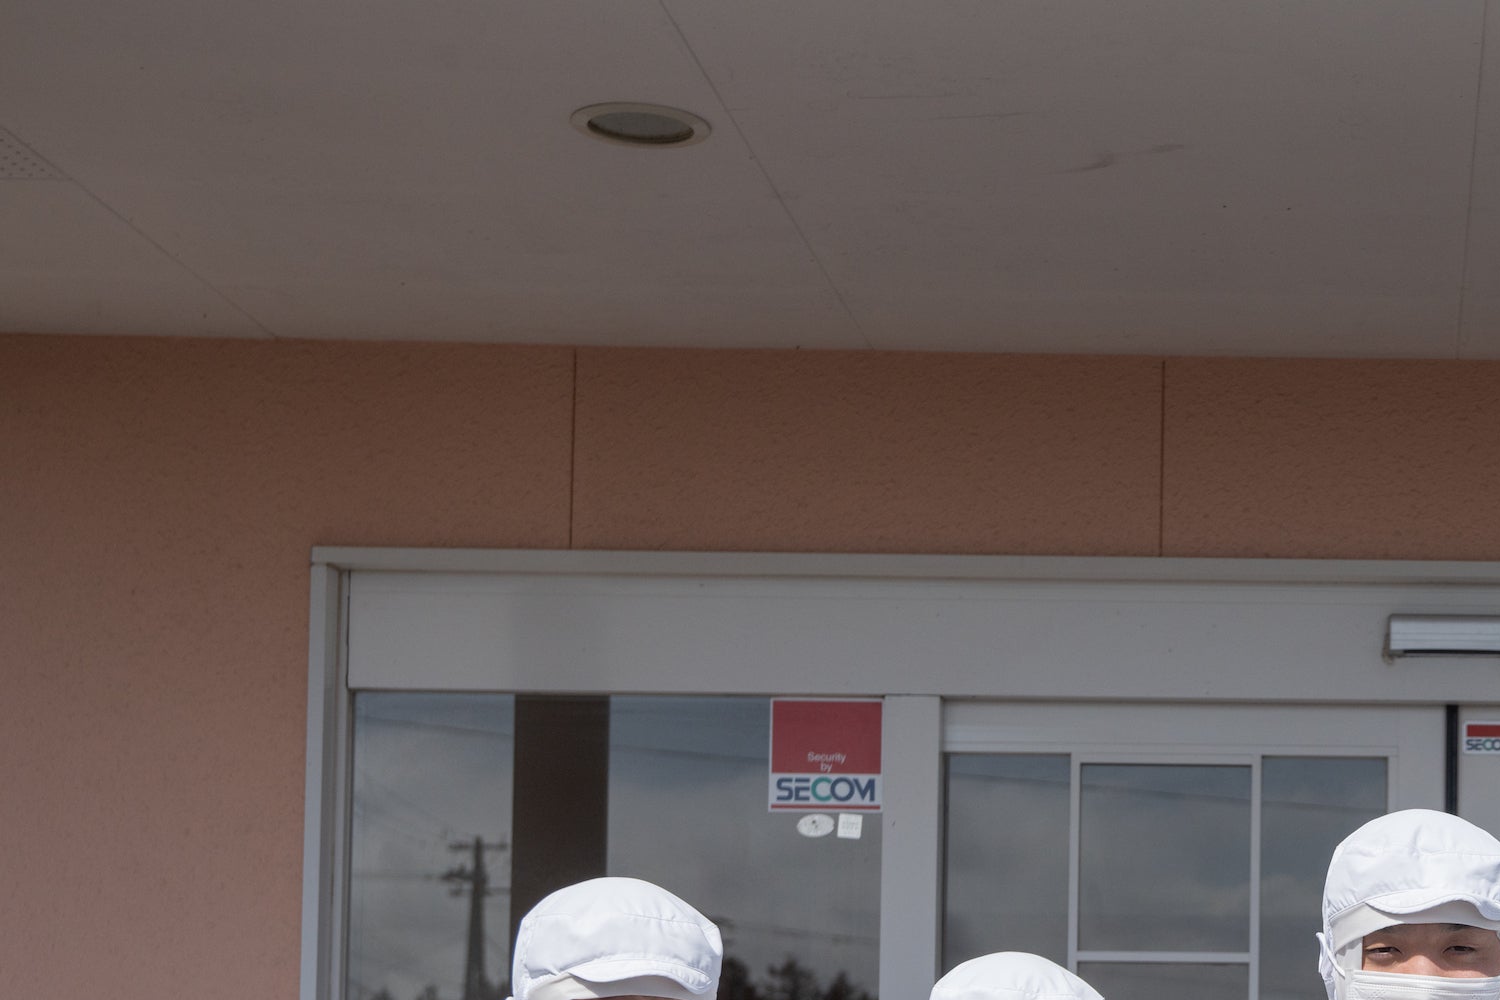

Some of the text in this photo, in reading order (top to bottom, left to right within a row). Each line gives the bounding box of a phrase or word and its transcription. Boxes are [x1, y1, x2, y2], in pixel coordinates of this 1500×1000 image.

[807, 752, 846, 764] Security
[820, 763, 832, 773] by
[776, 777, 876, 802] SECOM
